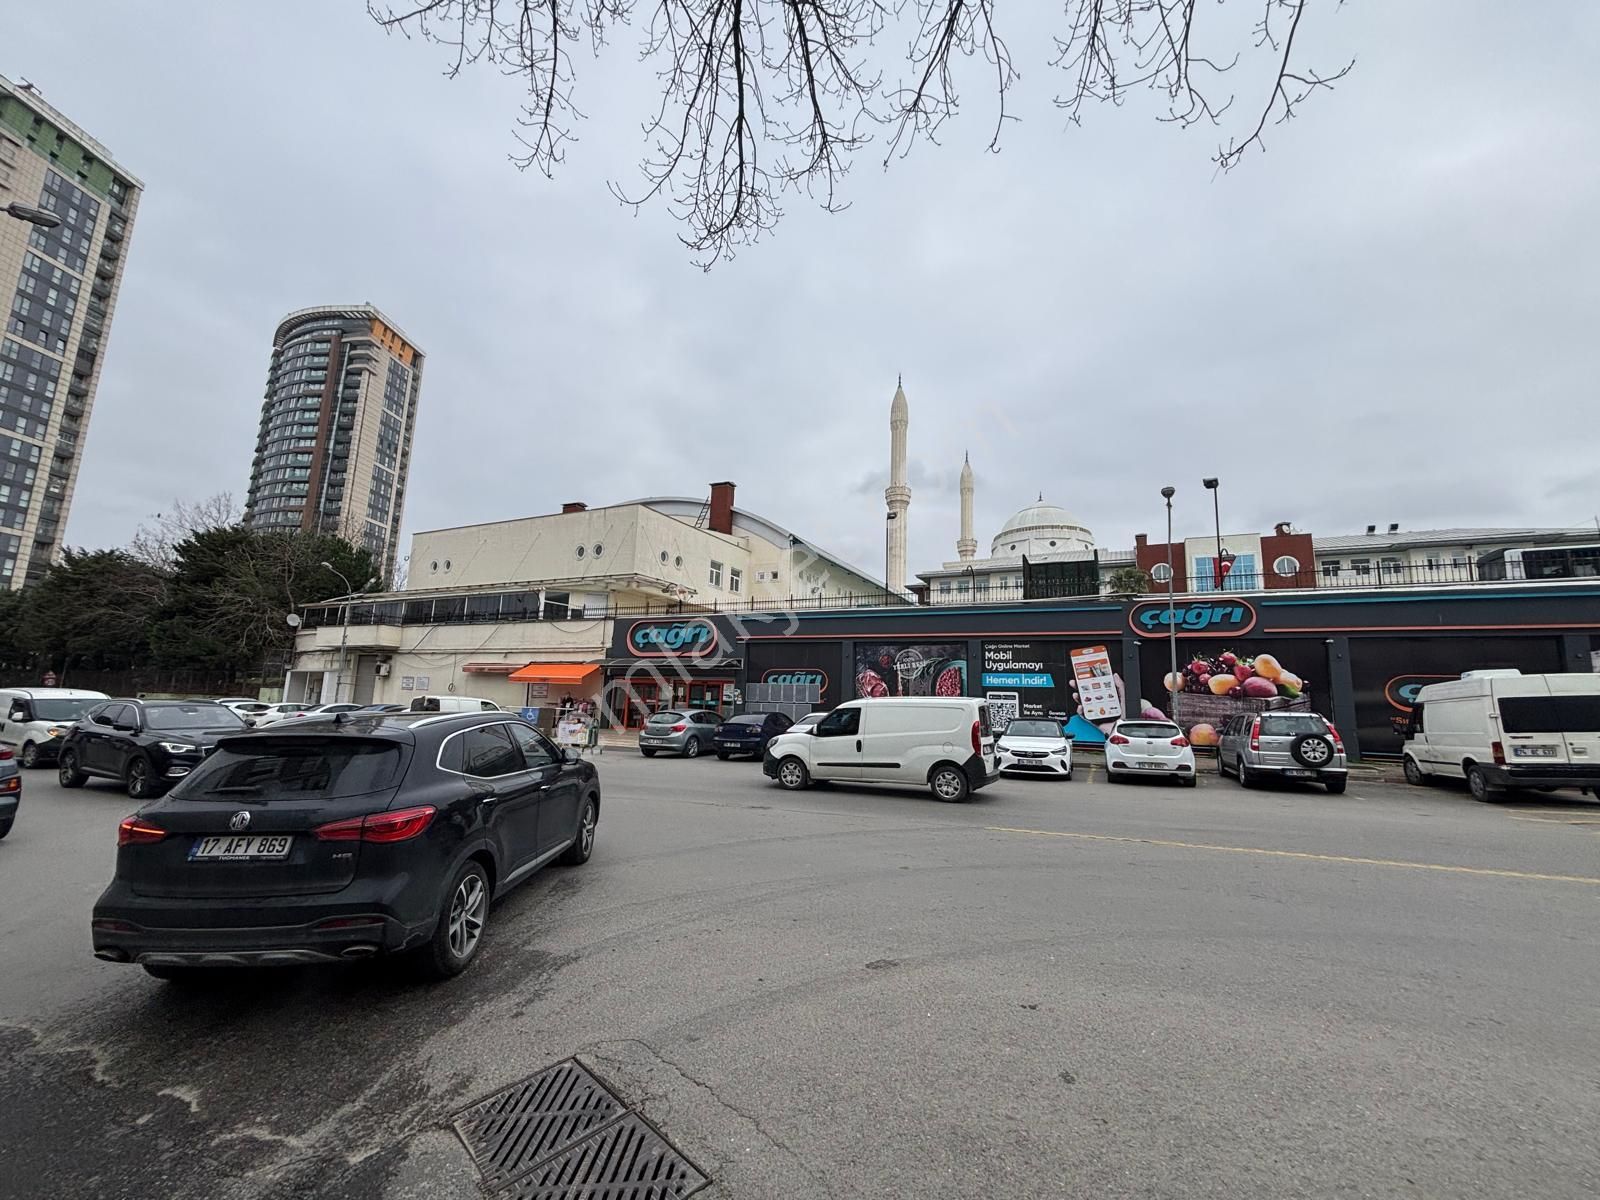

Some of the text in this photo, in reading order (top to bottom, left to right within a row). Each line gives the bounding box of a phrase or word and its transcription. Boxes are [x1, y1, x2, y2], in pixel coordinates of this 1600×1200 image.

[1139, 603, 1245, 630] çağrı
[634, 622, 709, 649] çağrı
[985, 651, 1012, 660] Mobil
[985, 660, 1043, 671] Uygulamayı
[986, 674, 1047, 685] Hemen İndir!
[201, 836, 288, 855] 17 AFY 869
